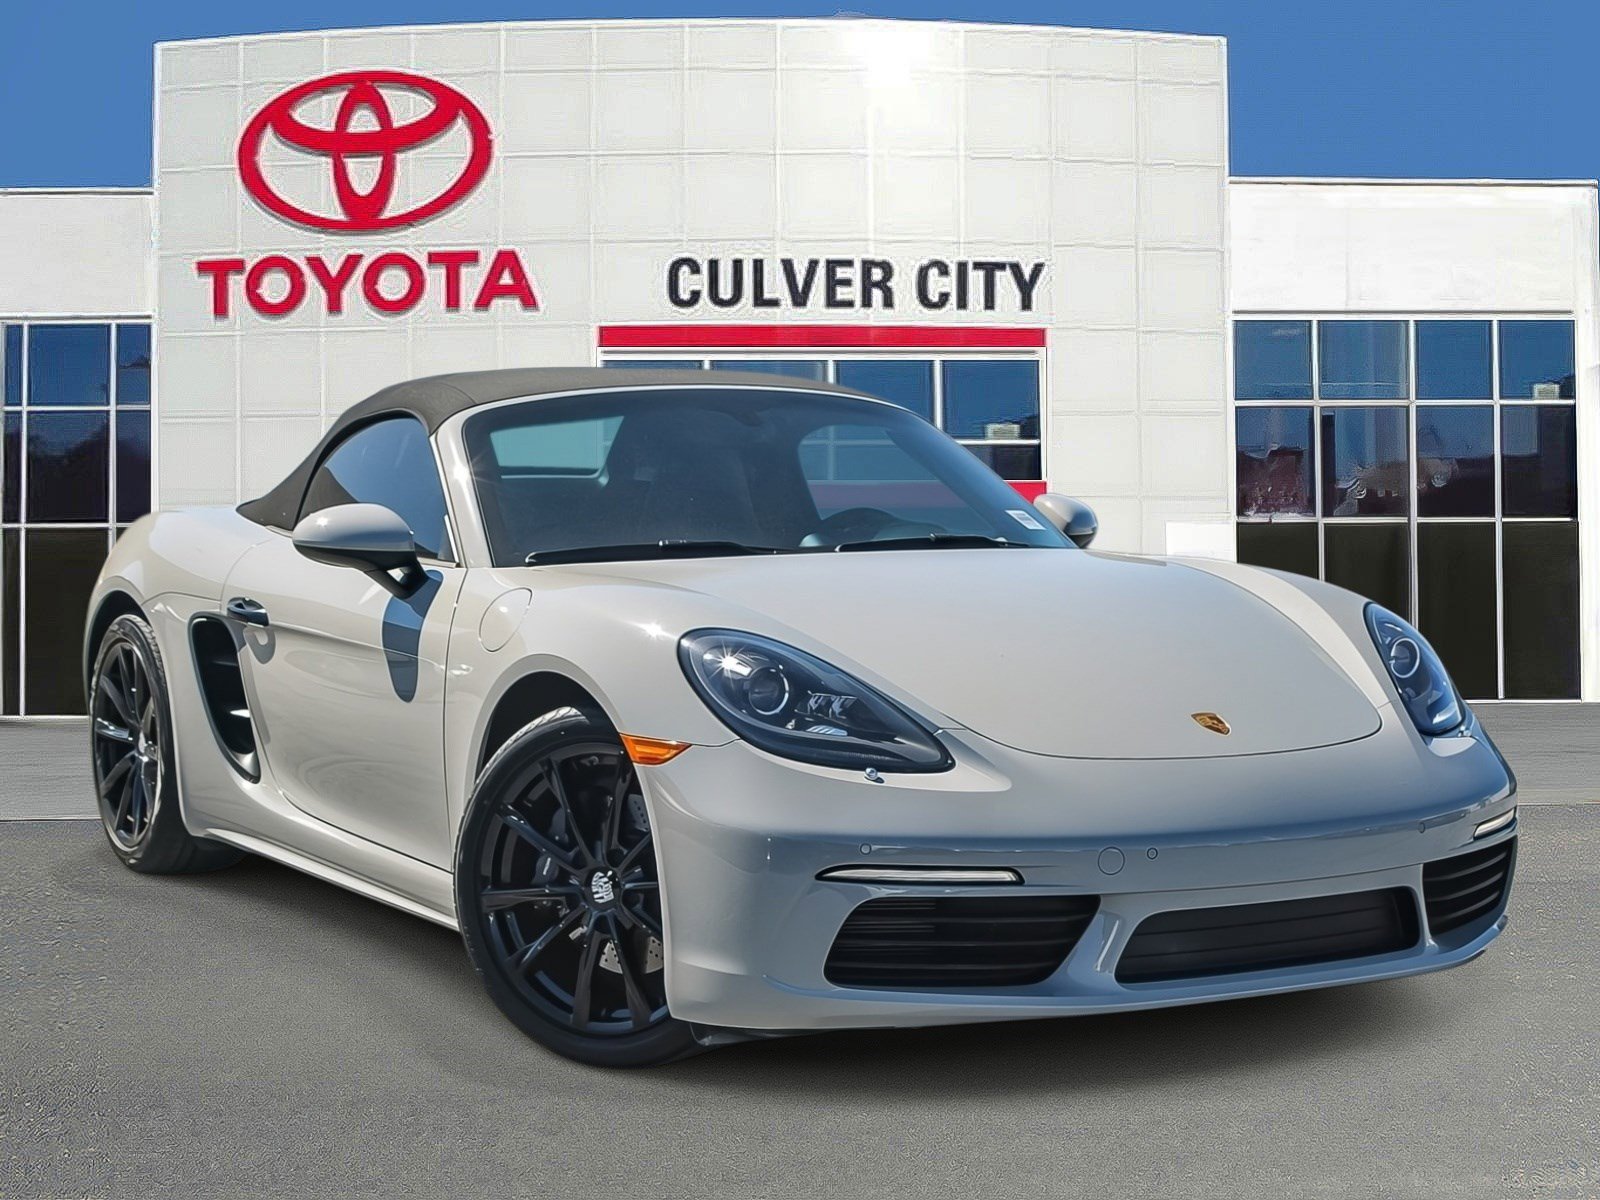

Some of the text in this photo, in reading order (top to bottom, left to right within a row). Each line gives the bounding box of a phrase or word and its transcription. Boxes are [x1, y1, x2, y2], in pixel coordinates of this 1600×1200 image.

[197, 249, 538, 318] TOYOTA
[667, 257, 1046, 312] CULVER CITY
